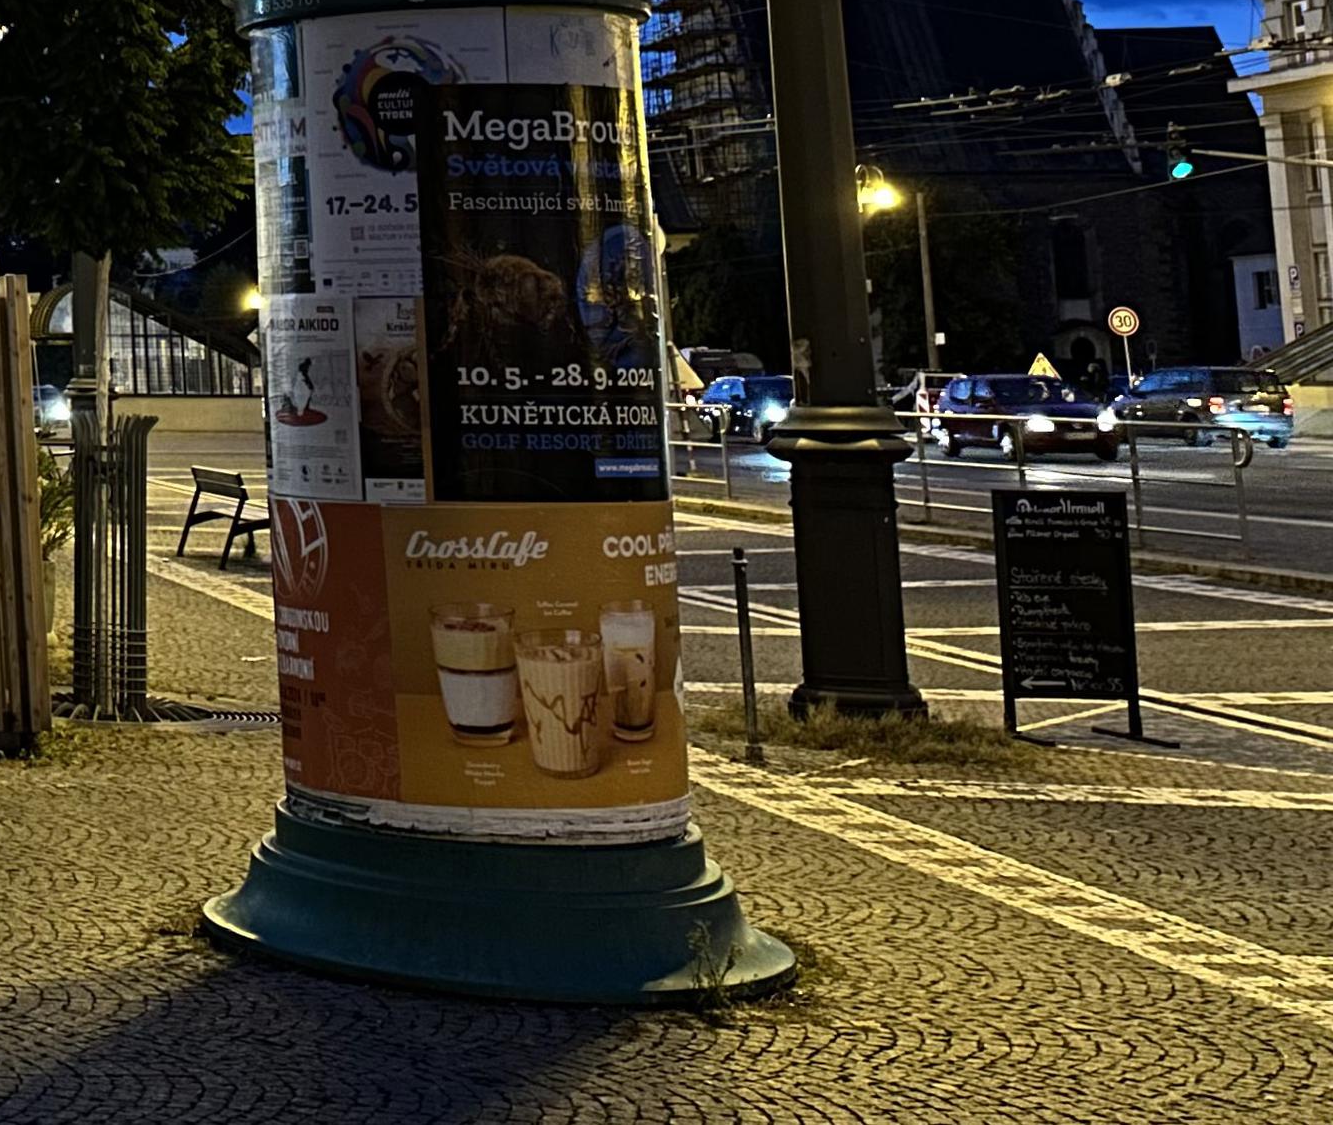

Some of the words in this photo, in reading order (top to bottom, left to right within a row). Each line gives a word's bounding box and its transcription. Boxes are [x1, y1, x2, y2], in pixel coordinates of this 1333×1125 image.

[446, 153, 561, 177] Světová
[448, 192, 563, 215] Fascinující
[567, 194, 602, 212] svět
[299, 319, 339, 331] AIKIDO
[1115, 315, 1132, 328] 30
[456, 366, 498, 386] 10.
[504, 366, 529, 390] 5.
[551, 363, 589, 386] 28.
[594, 368, 613, 390] 9.
[617, 368, 655, 391] 2024
[460, 401, 612, 426] KUNĚTICKÁ
[615, 405, 658, 426] HORA
[461, 432, 521, 451] GOLF
[526, 432, 603, 451] RESORT
[405, 530, 549, 567] CrossCafe
[603, 534, 656, 558] COOL
[406, 559, 456, 570] TŘÍDA
[468, 559, 510, 570] MÍRU
